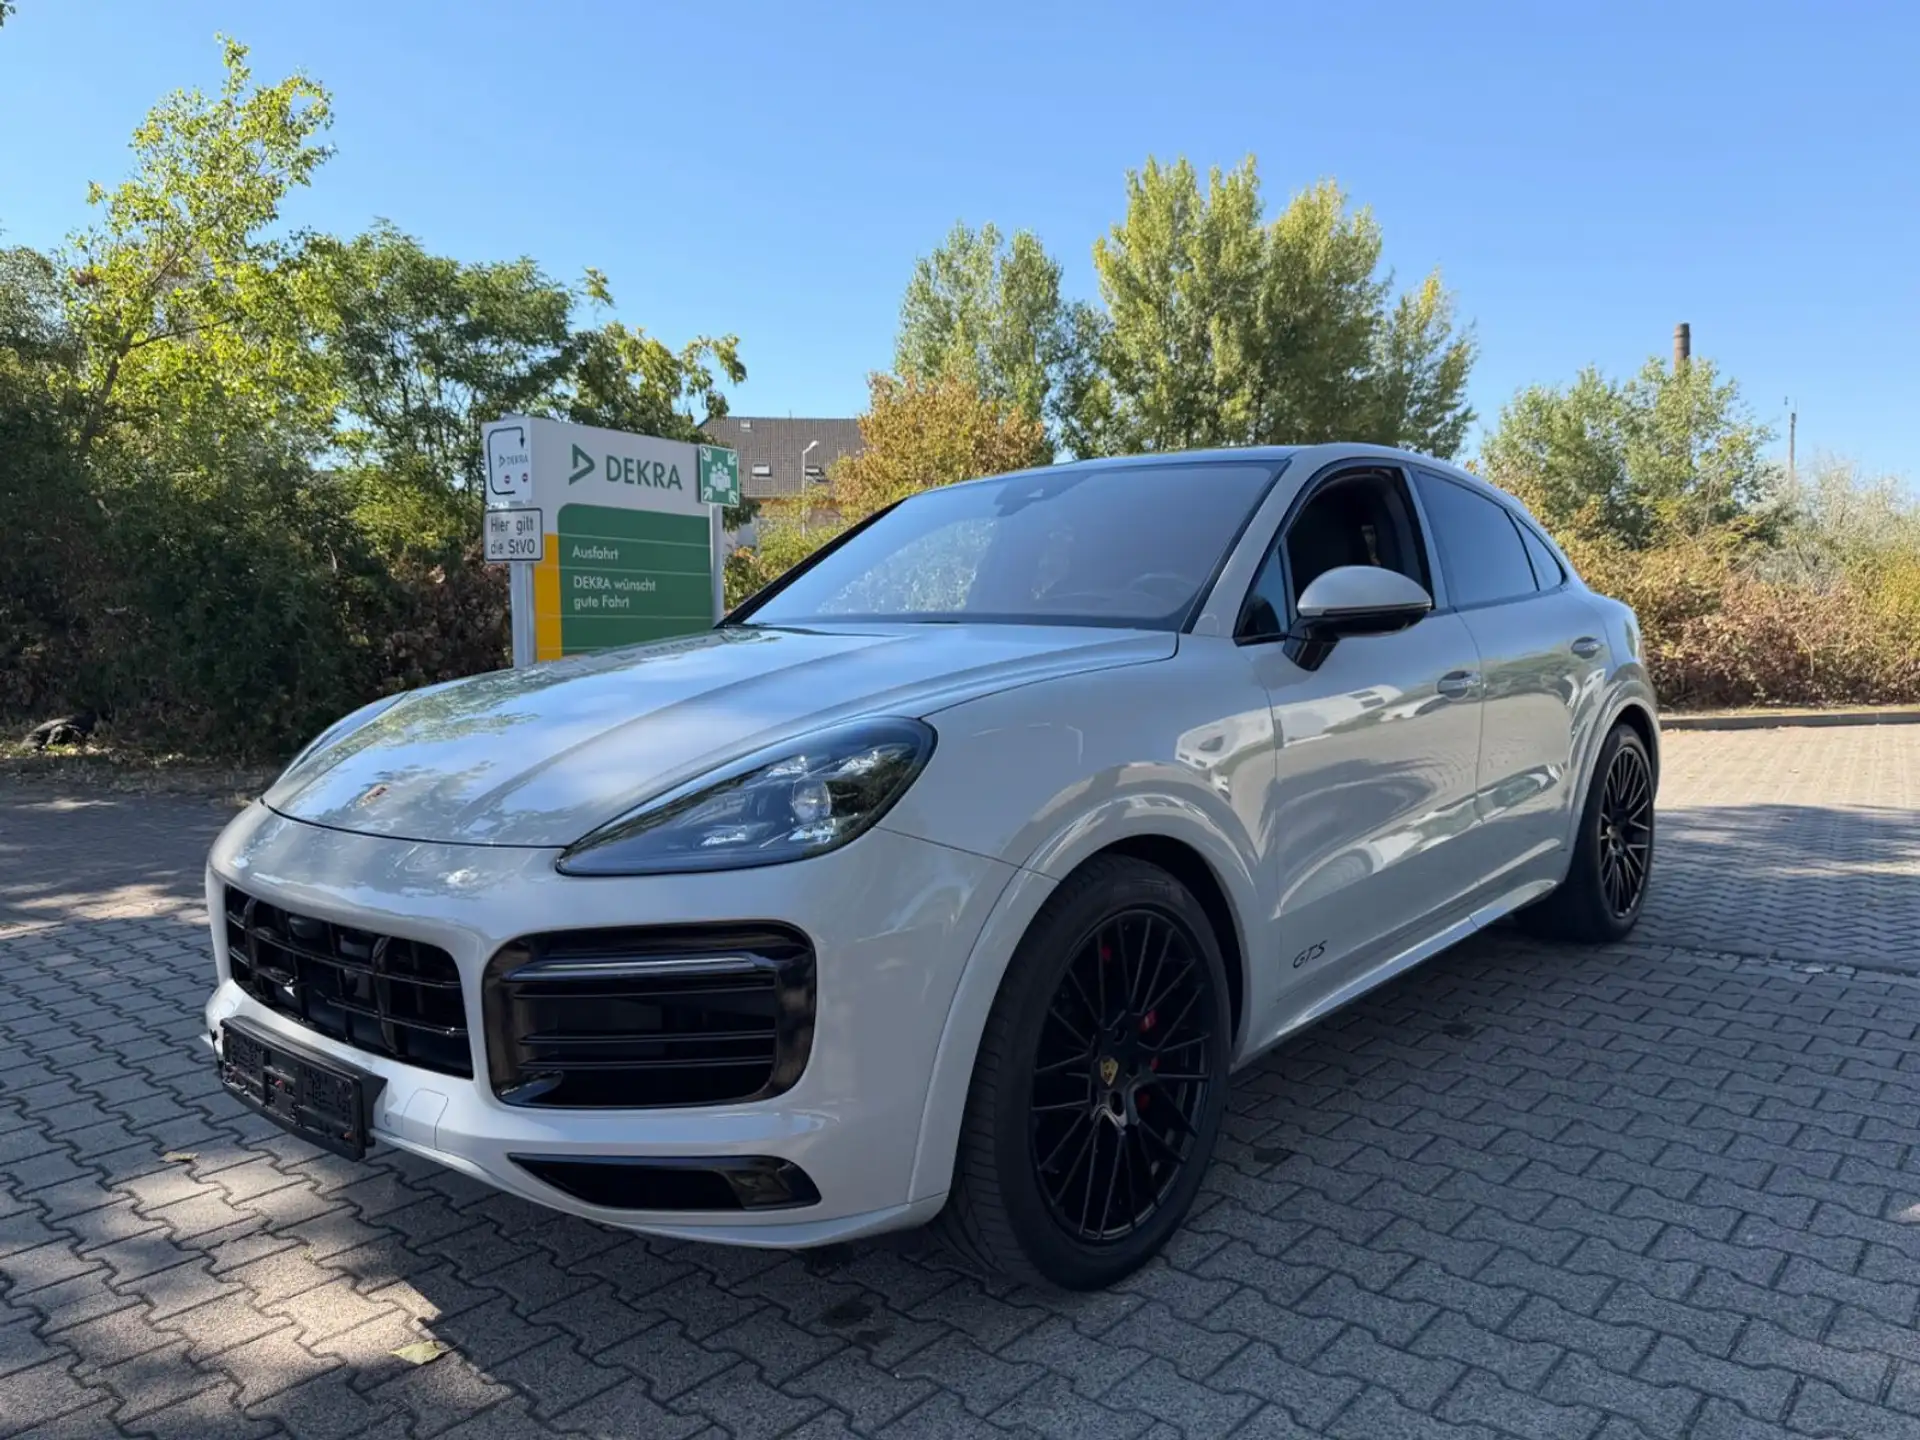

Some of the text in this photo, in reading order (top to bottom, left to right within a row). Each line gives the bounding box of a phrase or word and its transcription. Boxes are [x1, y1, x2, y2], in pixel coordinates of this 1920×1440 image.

[605, 455, 683, 491] DEKRA
[490, 516, 534, 535] Hier gilt
[508, 538, 536, 555] StVO
[572, 545, 619, 560] Ausfahrt
[573, 575, 656, 592] DEKRA wünscht
[573, 594, 630, 610] gute Fahrt
[1293, 940, 1327, 969] GTS
